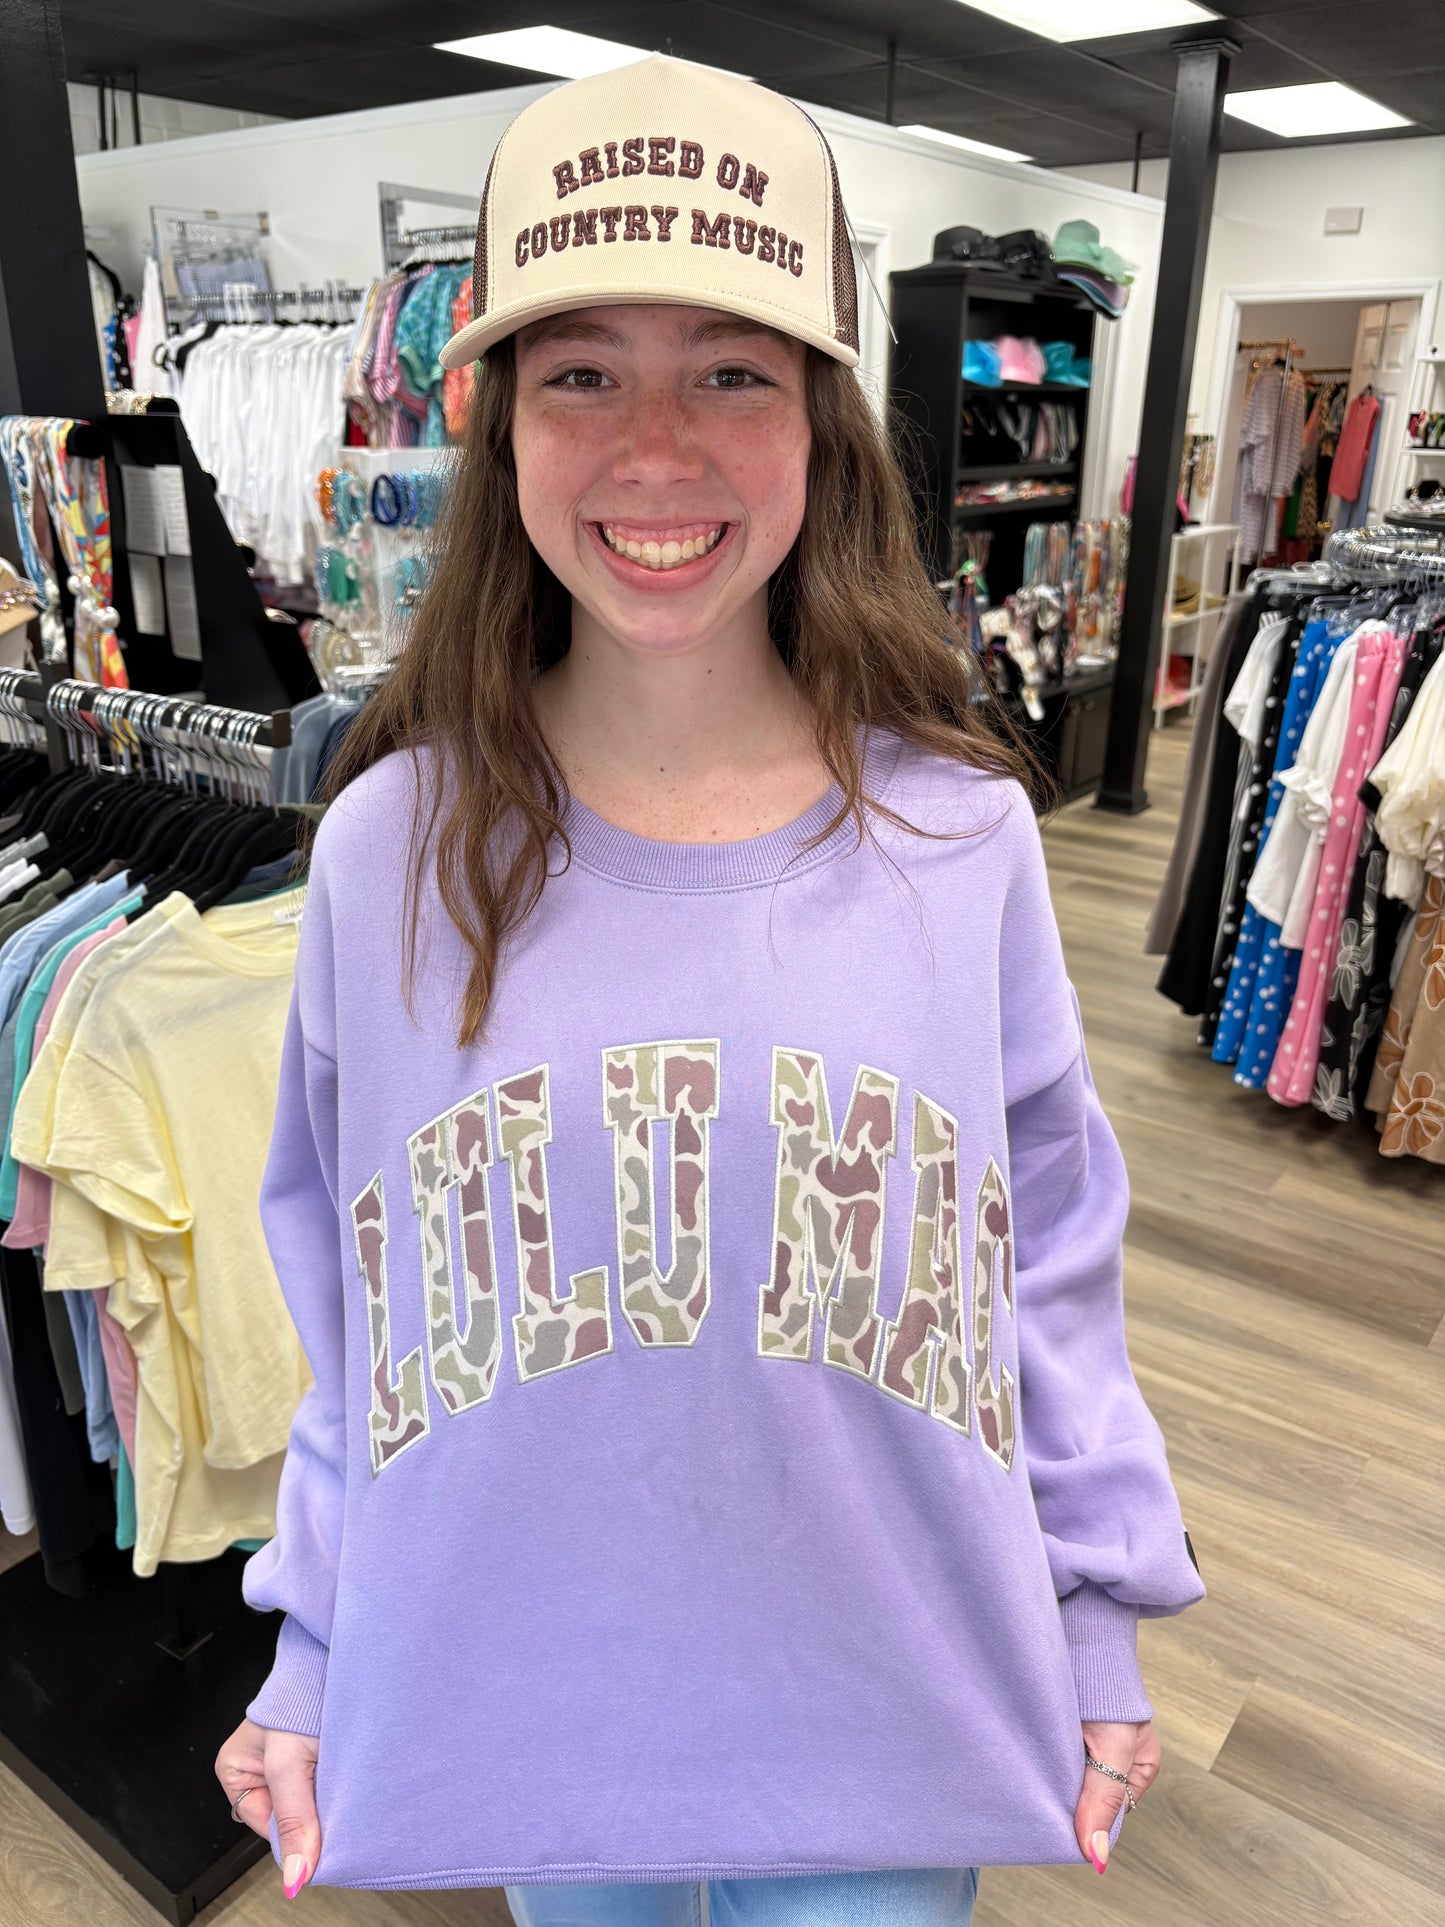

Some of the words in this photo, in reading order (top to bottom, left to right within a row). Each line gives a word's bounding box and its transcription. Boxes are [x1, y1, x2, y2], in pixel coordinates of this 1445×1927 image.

[552, 136, 705, 200] RAISED
[716, 152, 770, 207] ON
[514, 205, 679, 268] COUNTRY
[690, 208, 804, 278] MUSIC
[350, 1038, 720, 1480] LULU
[757, 1045, 1015, 1473] MAC
